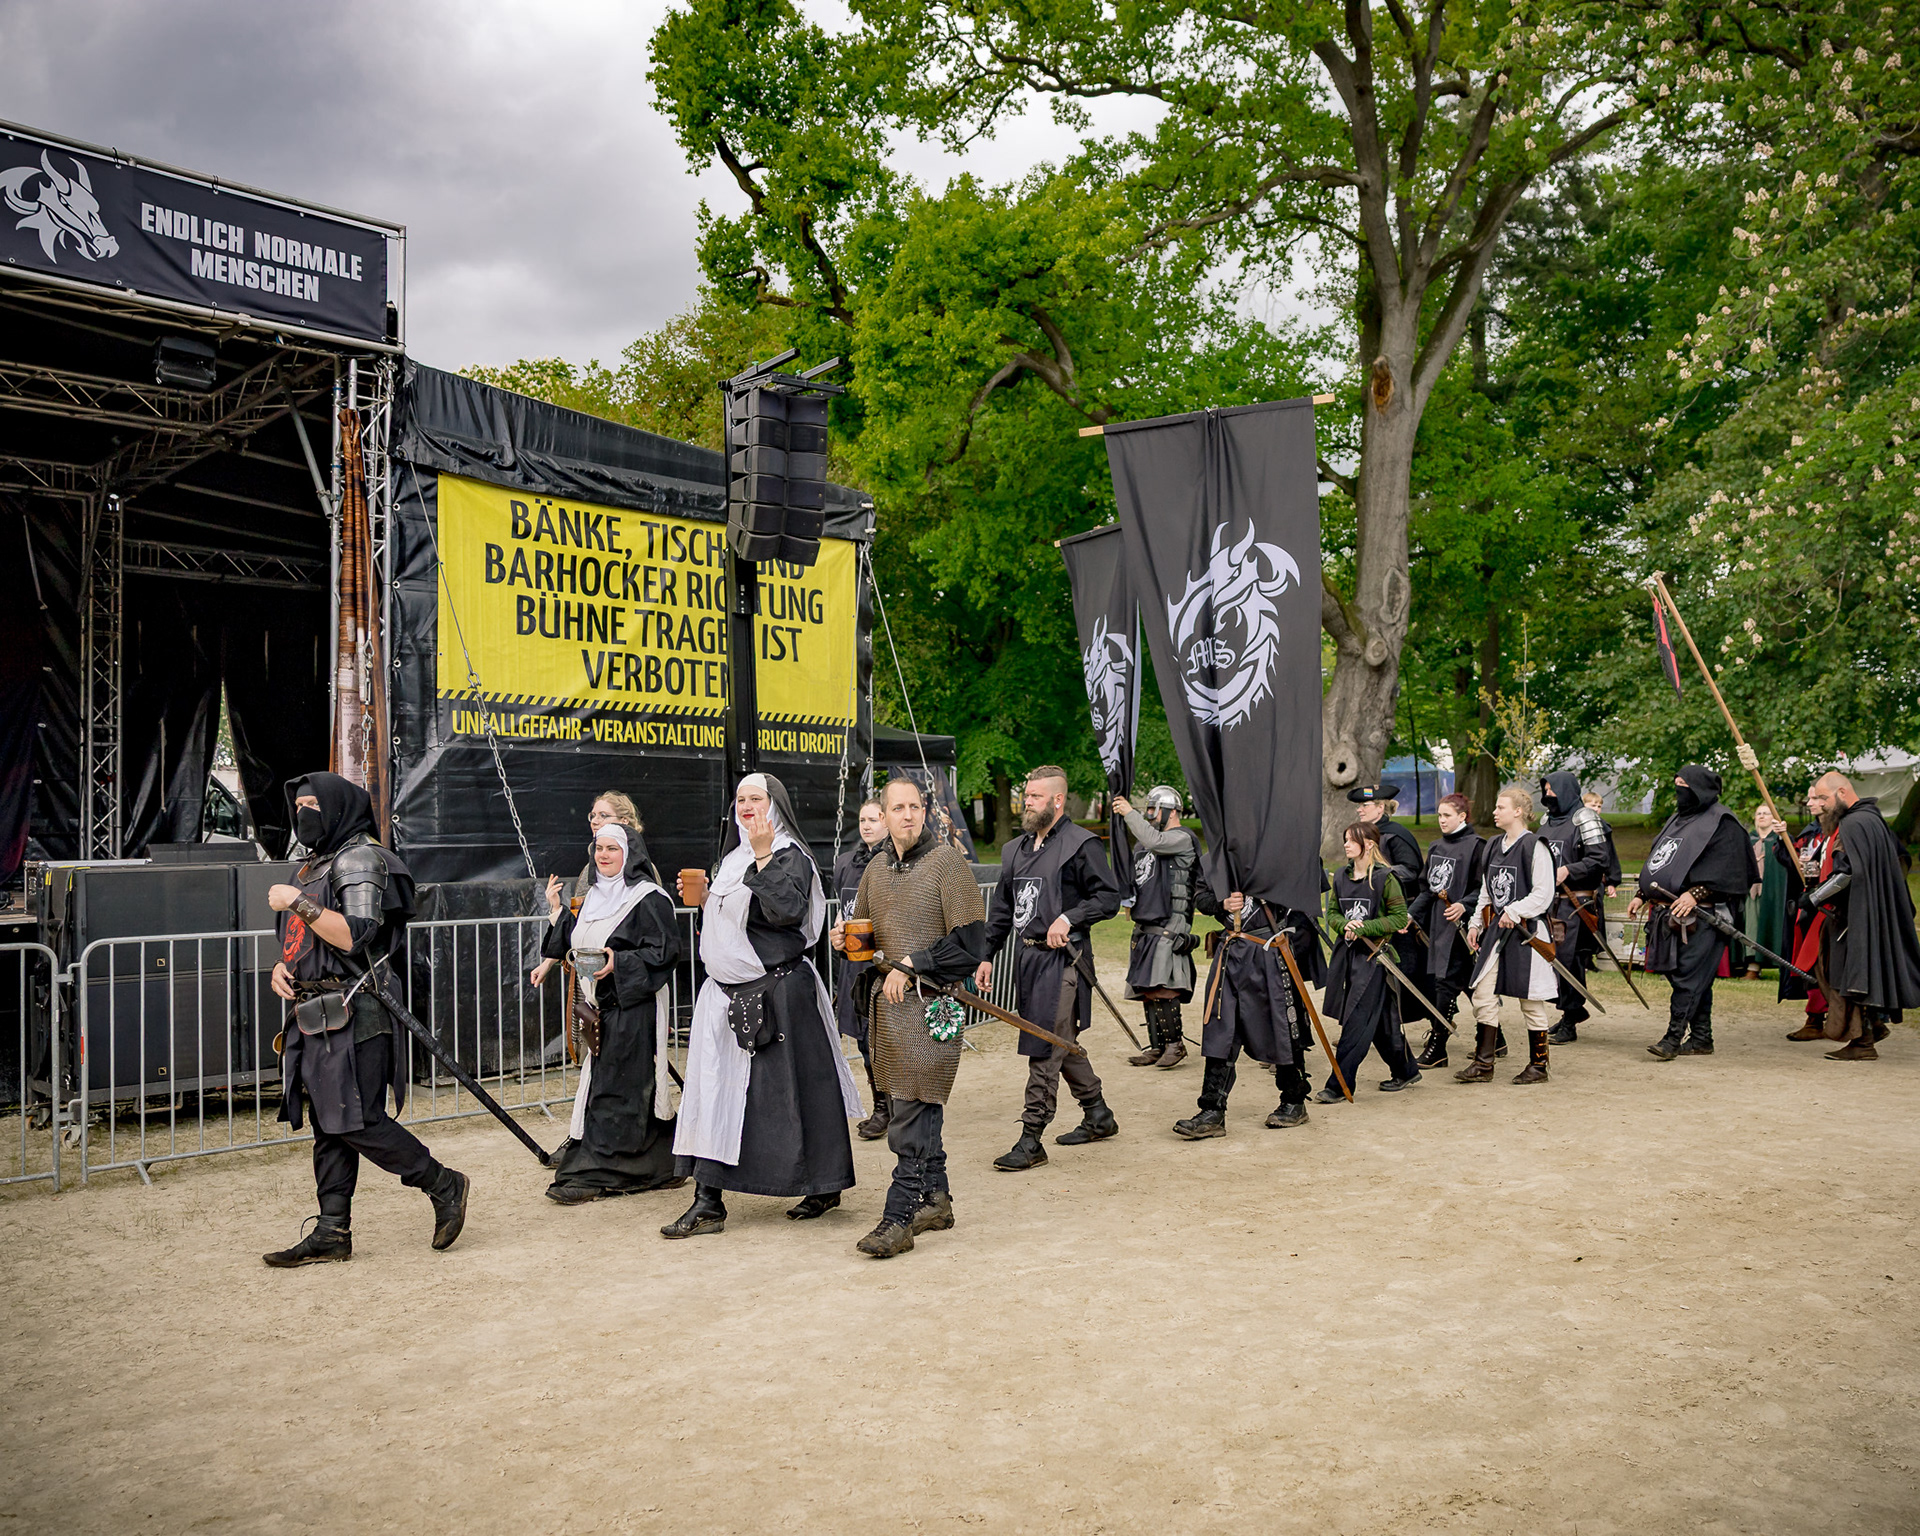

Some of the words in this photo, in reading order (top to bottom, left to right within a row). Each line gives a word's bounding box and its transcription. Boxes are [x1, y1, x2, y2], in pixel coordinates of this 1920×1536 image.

[141, 202, 244, 254] ENDLICH
[254, 231, 362, 282] NORMALE
[191, 248, 320, 302] MENSCHEN
[510, 498, 633, 560] BÄNKE,
[640, 520, 724, 568] TISCH
[485, 542, 678, 606] BARHOCKER
[686, 571, 824, 624] RICTUNG
[516, 591, 627, 645] BÜHNE
[634, 609, 727, 655] TRAGE
[762, 623, 802, 662] IST
